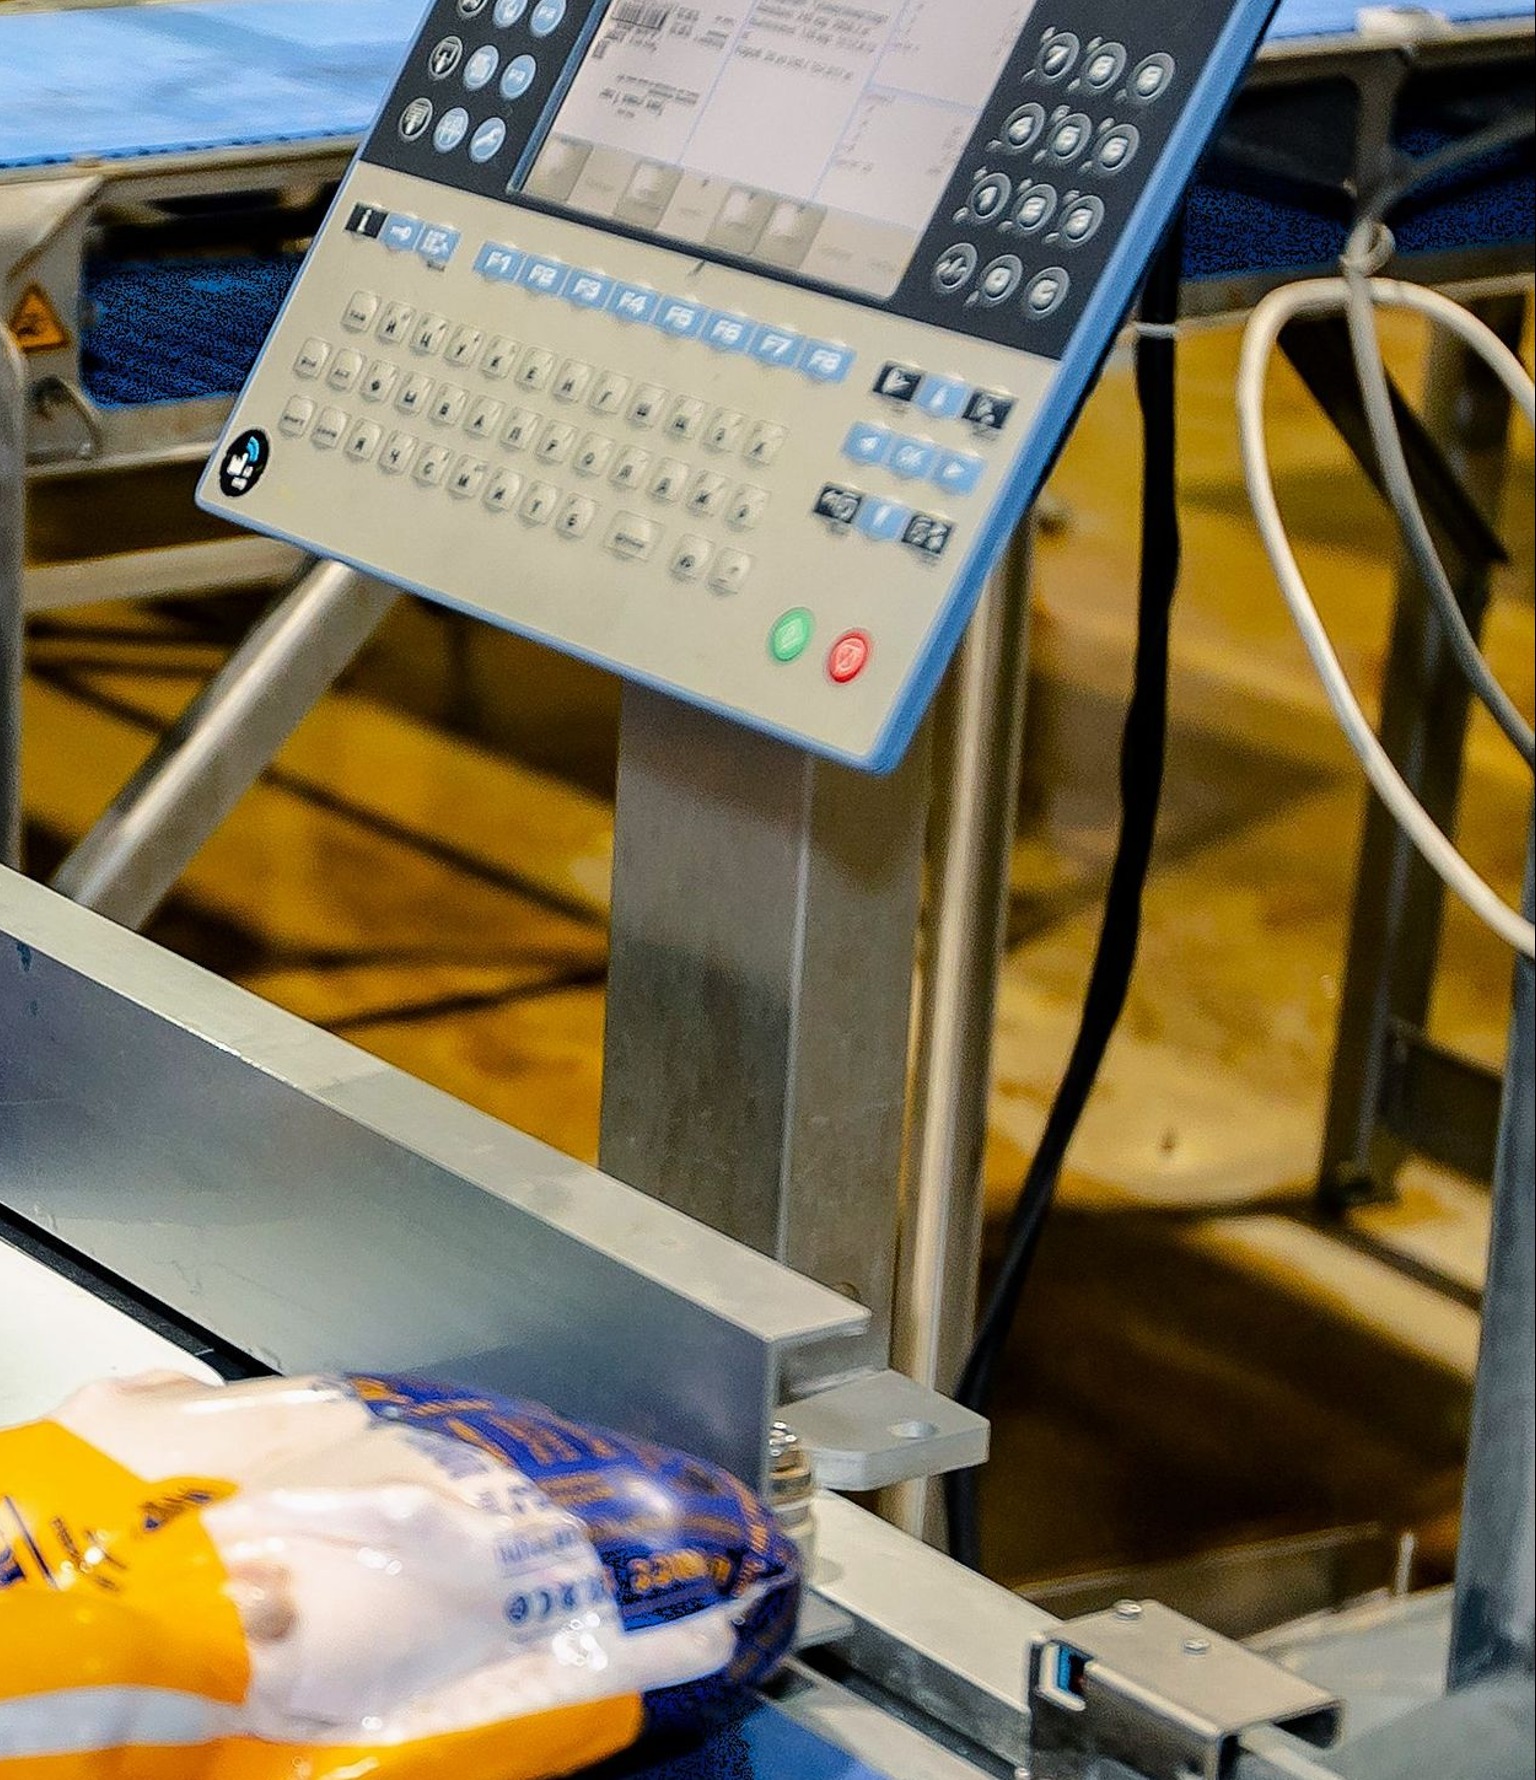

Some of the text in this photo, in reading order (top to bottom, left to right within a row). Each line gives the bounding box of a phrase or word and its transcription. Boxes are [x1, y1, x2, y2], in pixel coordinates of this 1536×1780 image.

[485, 251, 512, 273] F1
[527, 264, 557, 287] F2
[573, 278, 603, 300] F3
[615, 290, 648, 315] F4
[665, 305, 696, 328] F5
[713, 320, 744, 343] F6
[760, 336, 793, 358] F7
[808, 350, 842, 374] F8
